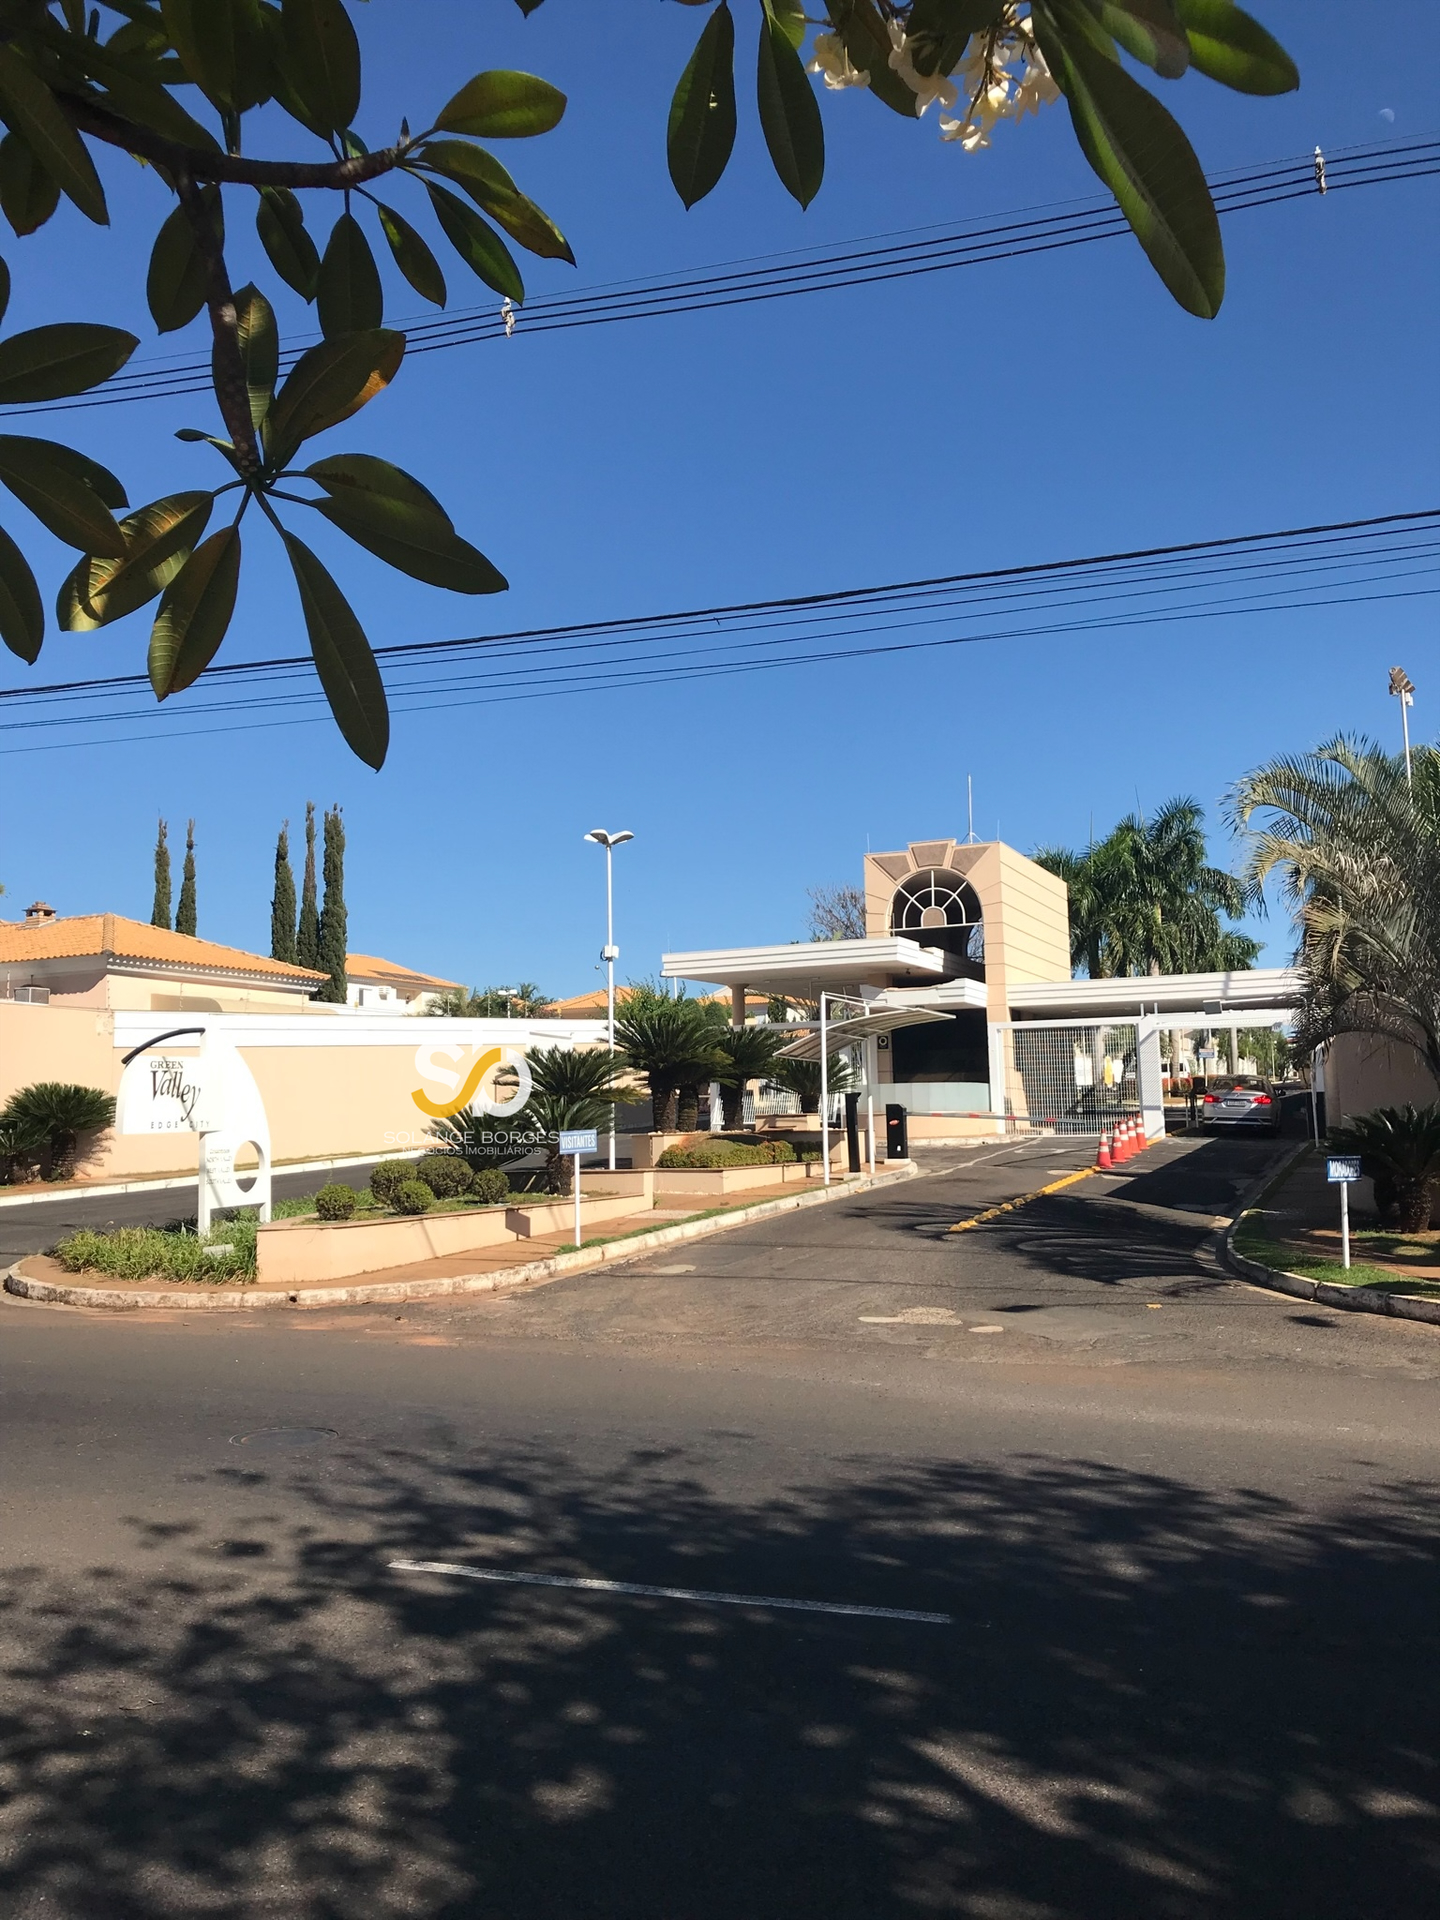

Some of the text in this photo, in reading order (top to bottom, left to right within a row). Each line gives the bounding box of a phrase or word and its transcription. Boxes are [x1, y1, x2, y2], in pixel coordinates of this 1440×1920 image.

[150, 1060, 184, 1070] GREEN
[150, 1070, 202, 1122] Valley
[150, 1120, 211, 1130] EDGE CITY
[562, 1133, 597, 1150] VISITANTES
